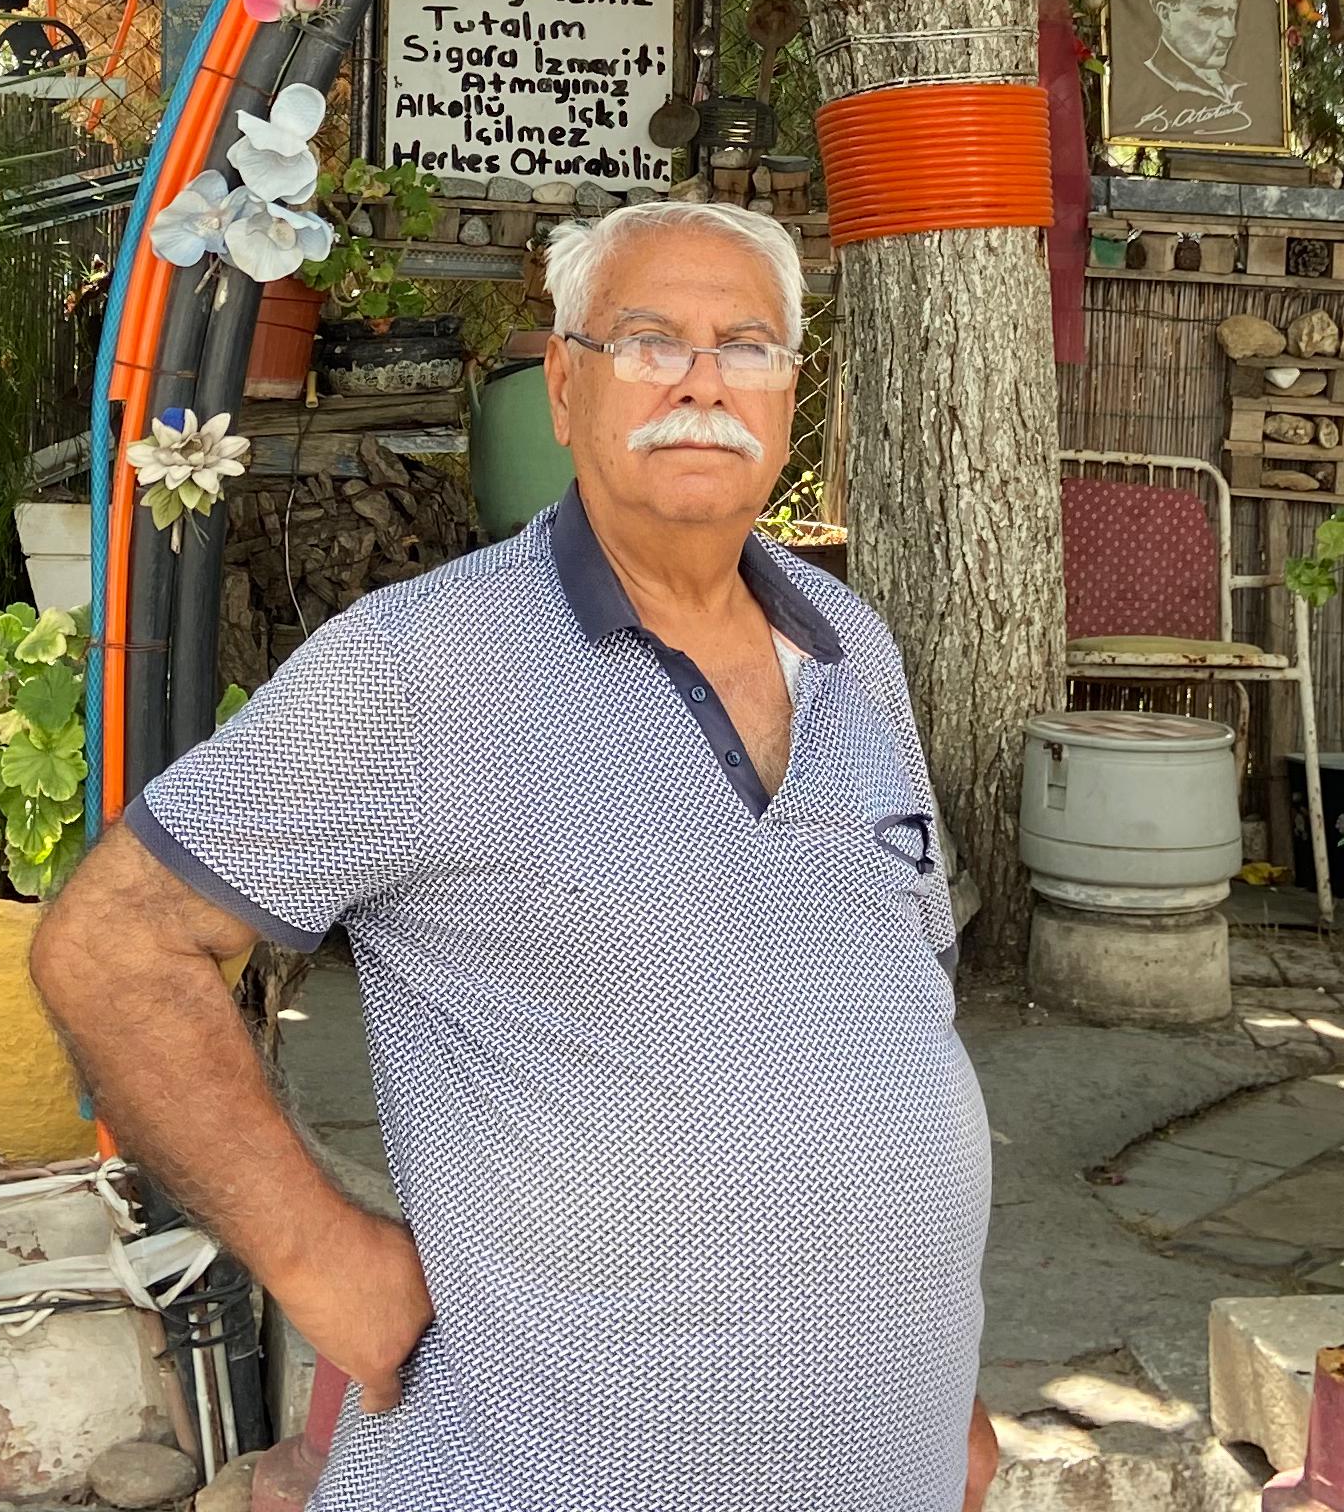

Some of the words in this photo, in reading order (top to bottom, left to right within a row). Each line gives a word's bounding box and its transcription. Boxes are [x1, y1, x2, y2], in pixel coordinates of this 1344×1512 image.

[422, 5, 585, 41] Tutalım
[402, 34, 518, 73] Sigara
[395, 93, 505, 118] Alkollü
[461, 72, 629, 104] Atmayınız
[393, 139, 501, 174] Herkes
[510, 145, 670, 182] Oturabilir.
